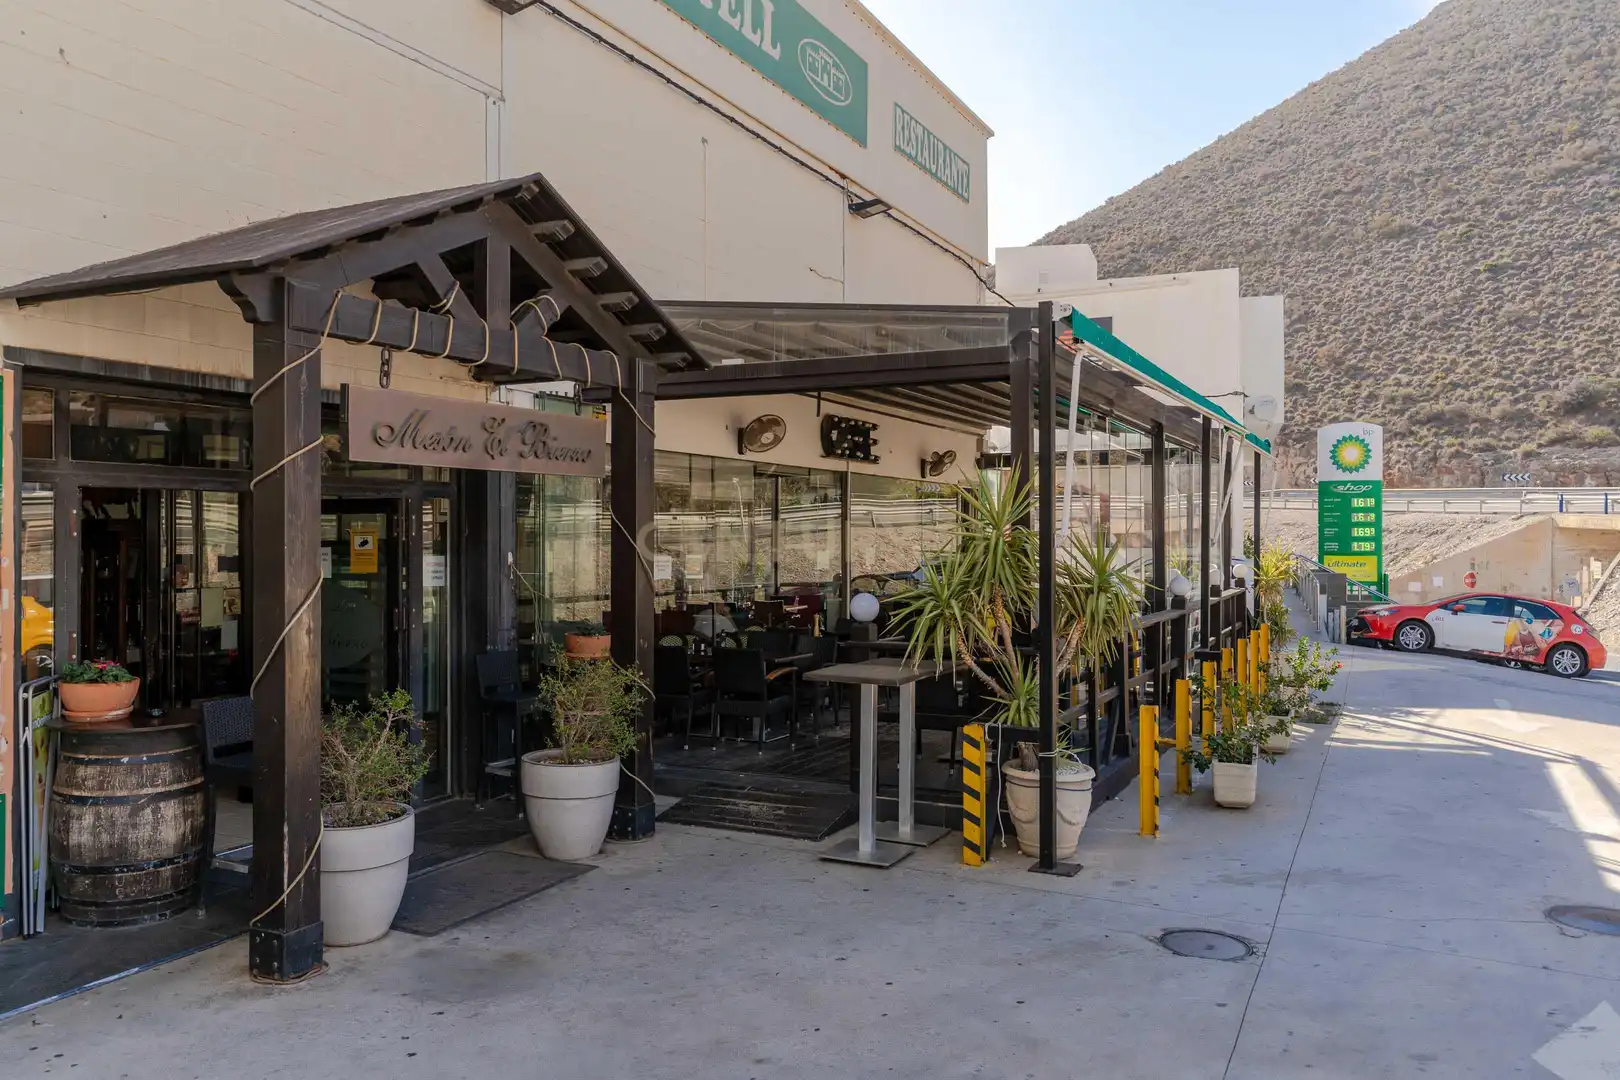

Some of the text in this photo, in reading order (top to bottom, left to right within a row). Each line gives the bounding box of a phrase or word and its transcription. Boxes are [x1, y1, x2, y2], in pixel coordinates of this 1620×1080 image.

[700, 0, 781, 60] ELL
[896, 105, 969, 197] RESTAURANTE
[480, 416, 509, 460] El
[1362, 427, 1375, 436] bp
[1336, 482, 1373, 493] shop
